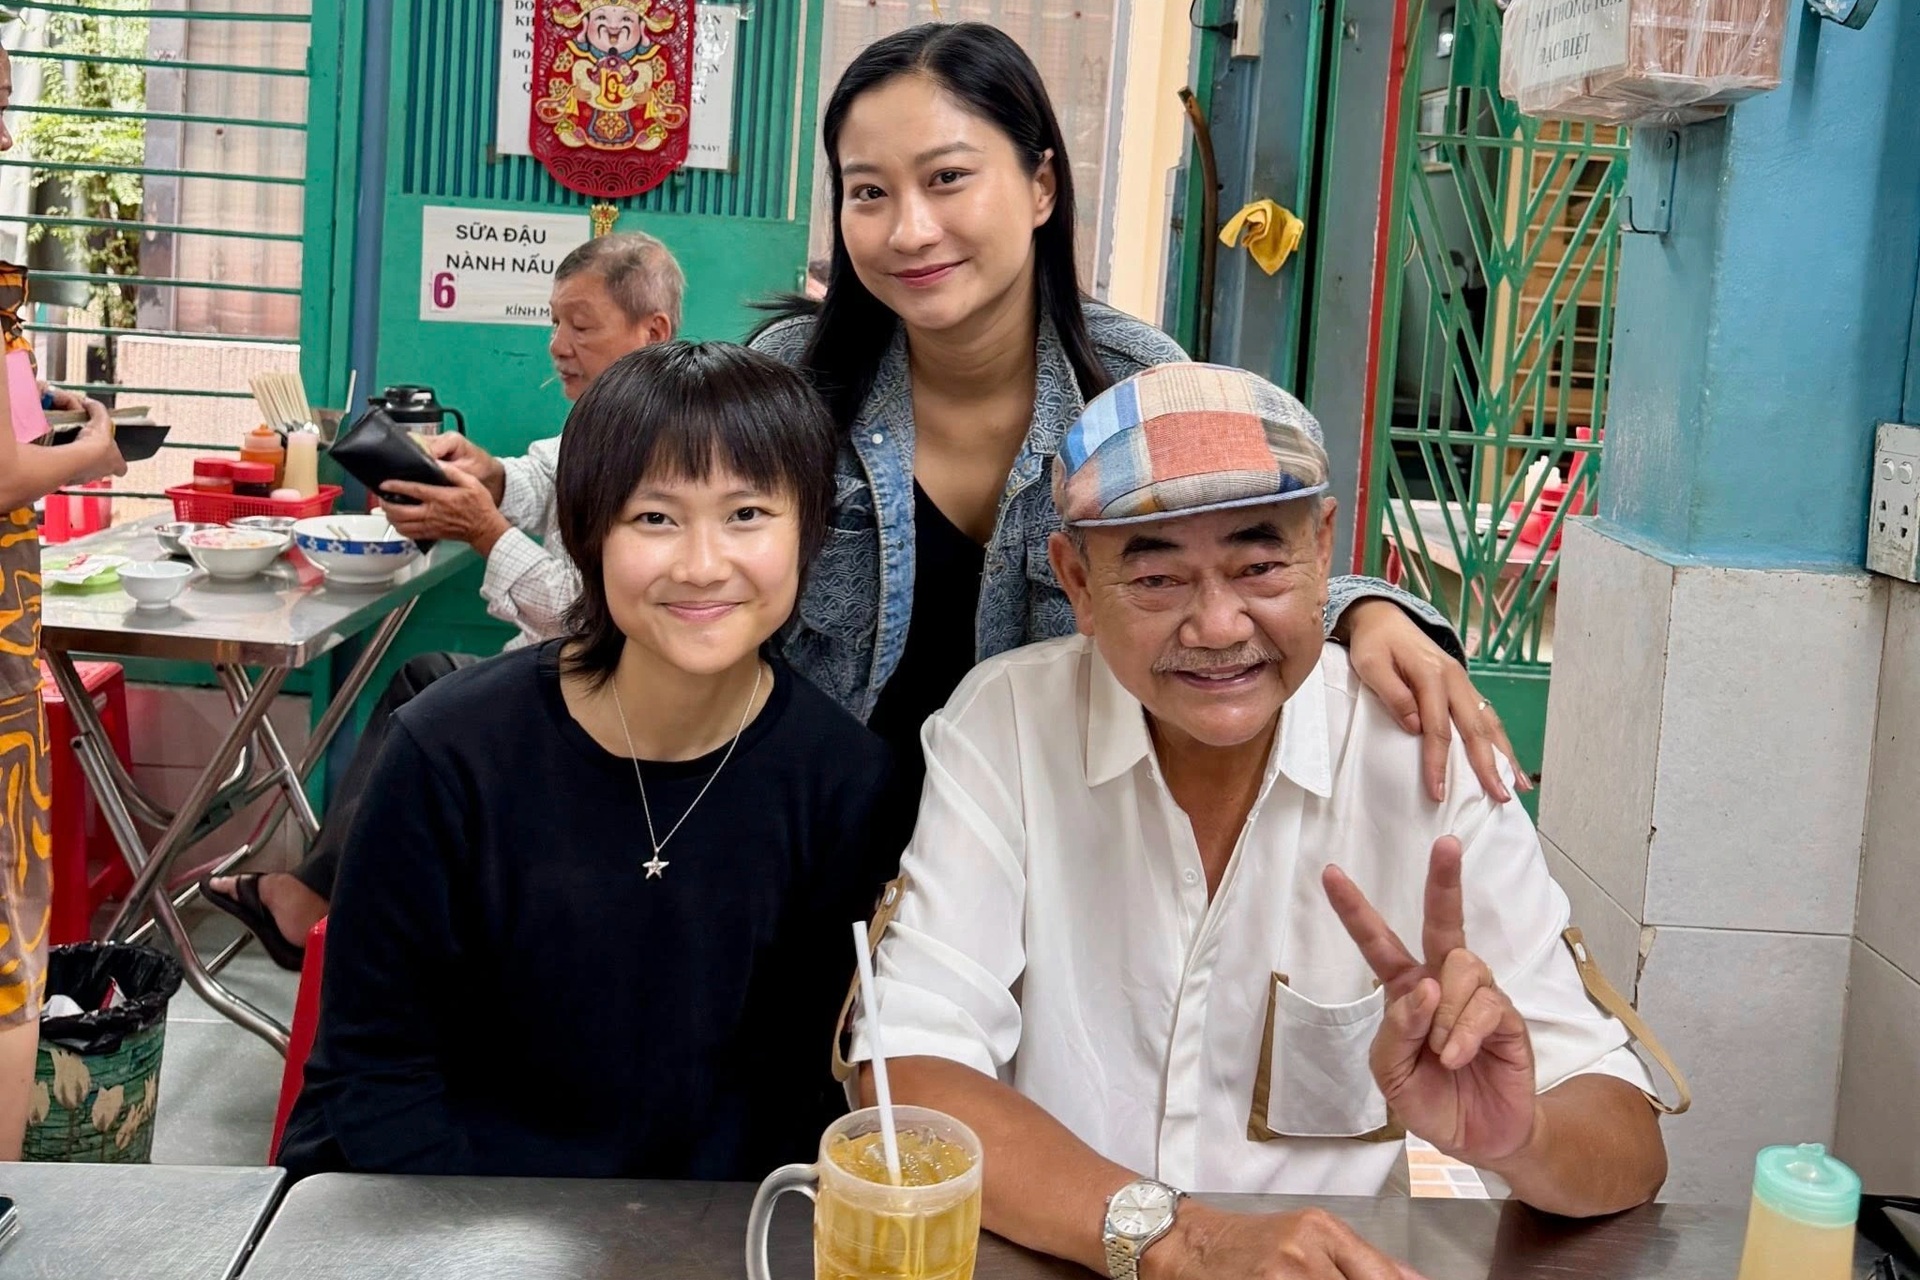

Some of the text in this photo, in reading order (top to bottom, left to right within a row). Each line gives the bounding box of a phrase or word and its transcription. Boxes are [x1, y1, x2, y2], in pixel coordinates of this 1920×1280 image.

[456, 221, 546, 247] SỮA ĐẬU
[446, 250, 554, 275] NÀNH NẤU
[433, 271, 456, 309] 6
[505, 303, 536, 317] KÍNH
